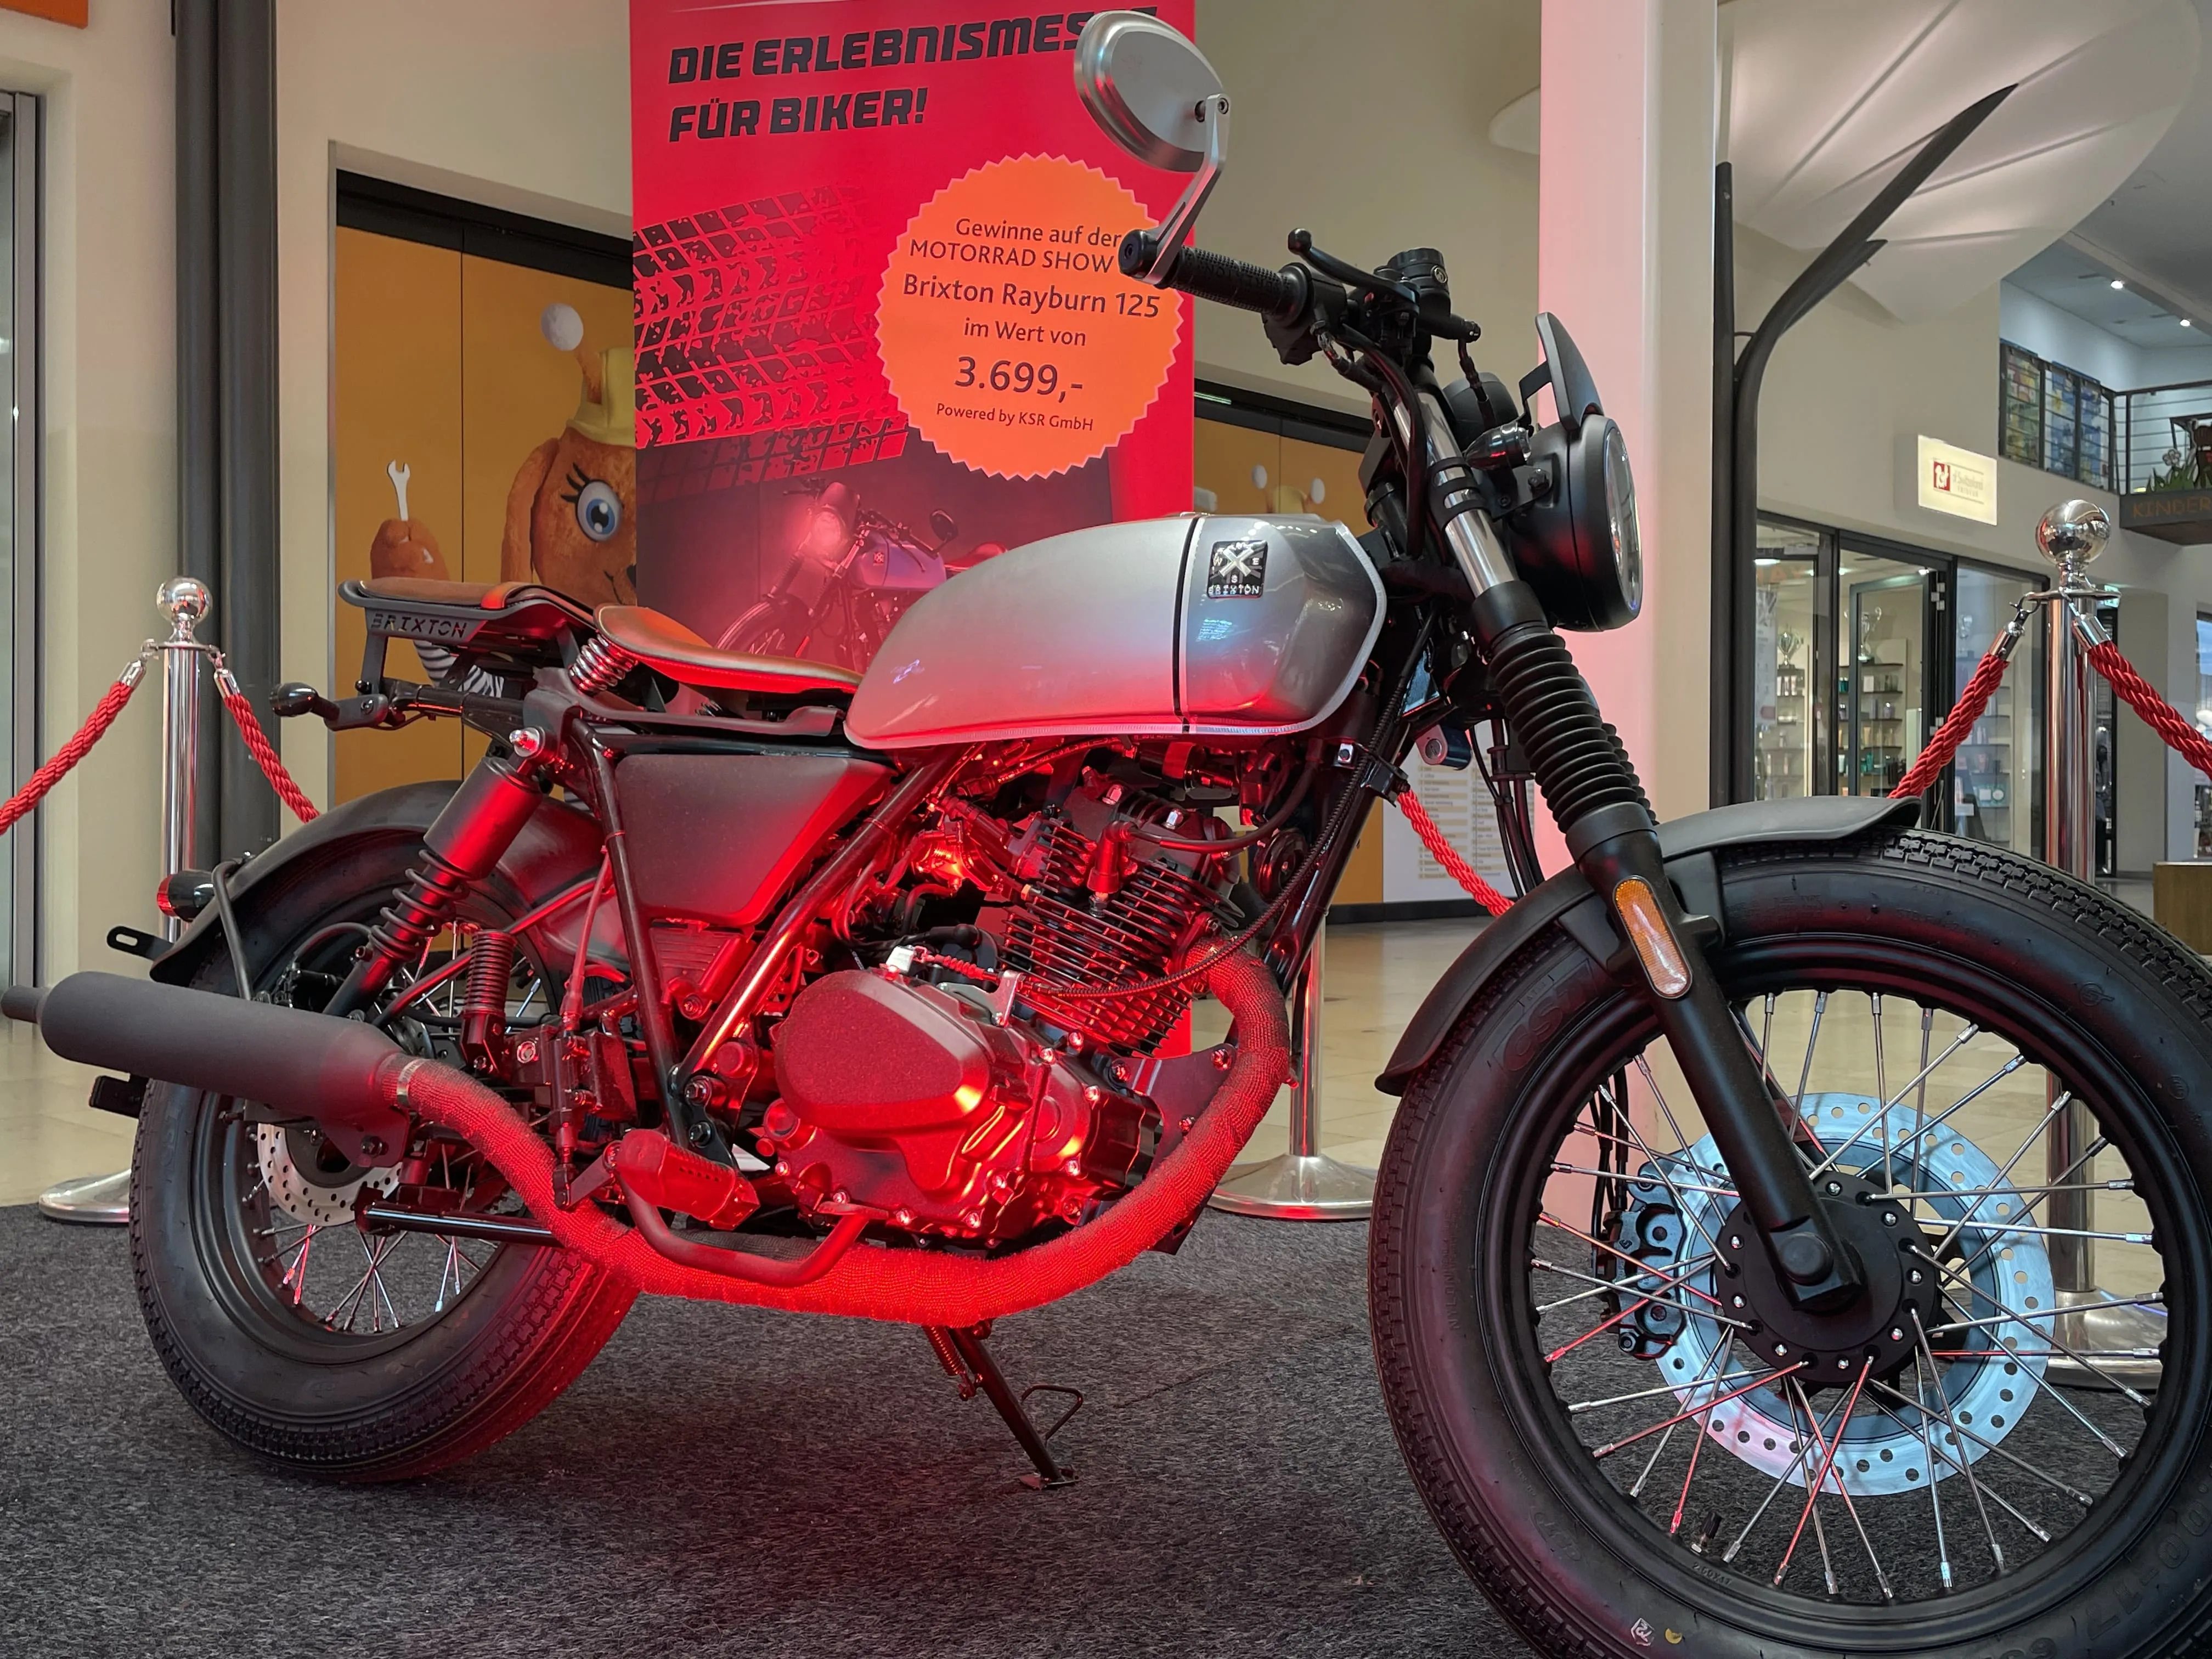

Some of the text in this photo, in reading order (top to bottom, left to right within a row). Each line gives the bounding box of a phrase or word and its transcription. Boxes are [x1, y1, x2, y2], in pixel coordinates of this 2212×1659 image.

[669, 7, 1157, 84] DIE ERLEBNISMES
[669, 87, 928, 143] FÜR BIKER!
[956, 218, 1121, 248] Gewinne auf der
[910, 239, 1115, 273] MOTORRAD SHOW
[903, 274, 1160, 318] Brixton Rayburn 125
[963, 318, 1086, 346] im Wert von
[955, 356, 1083, 403] 3.699,-
[936, 403, 1093, 431] Powered by KSR GmbH
[371, 613, 467, 638] BRIXTON
